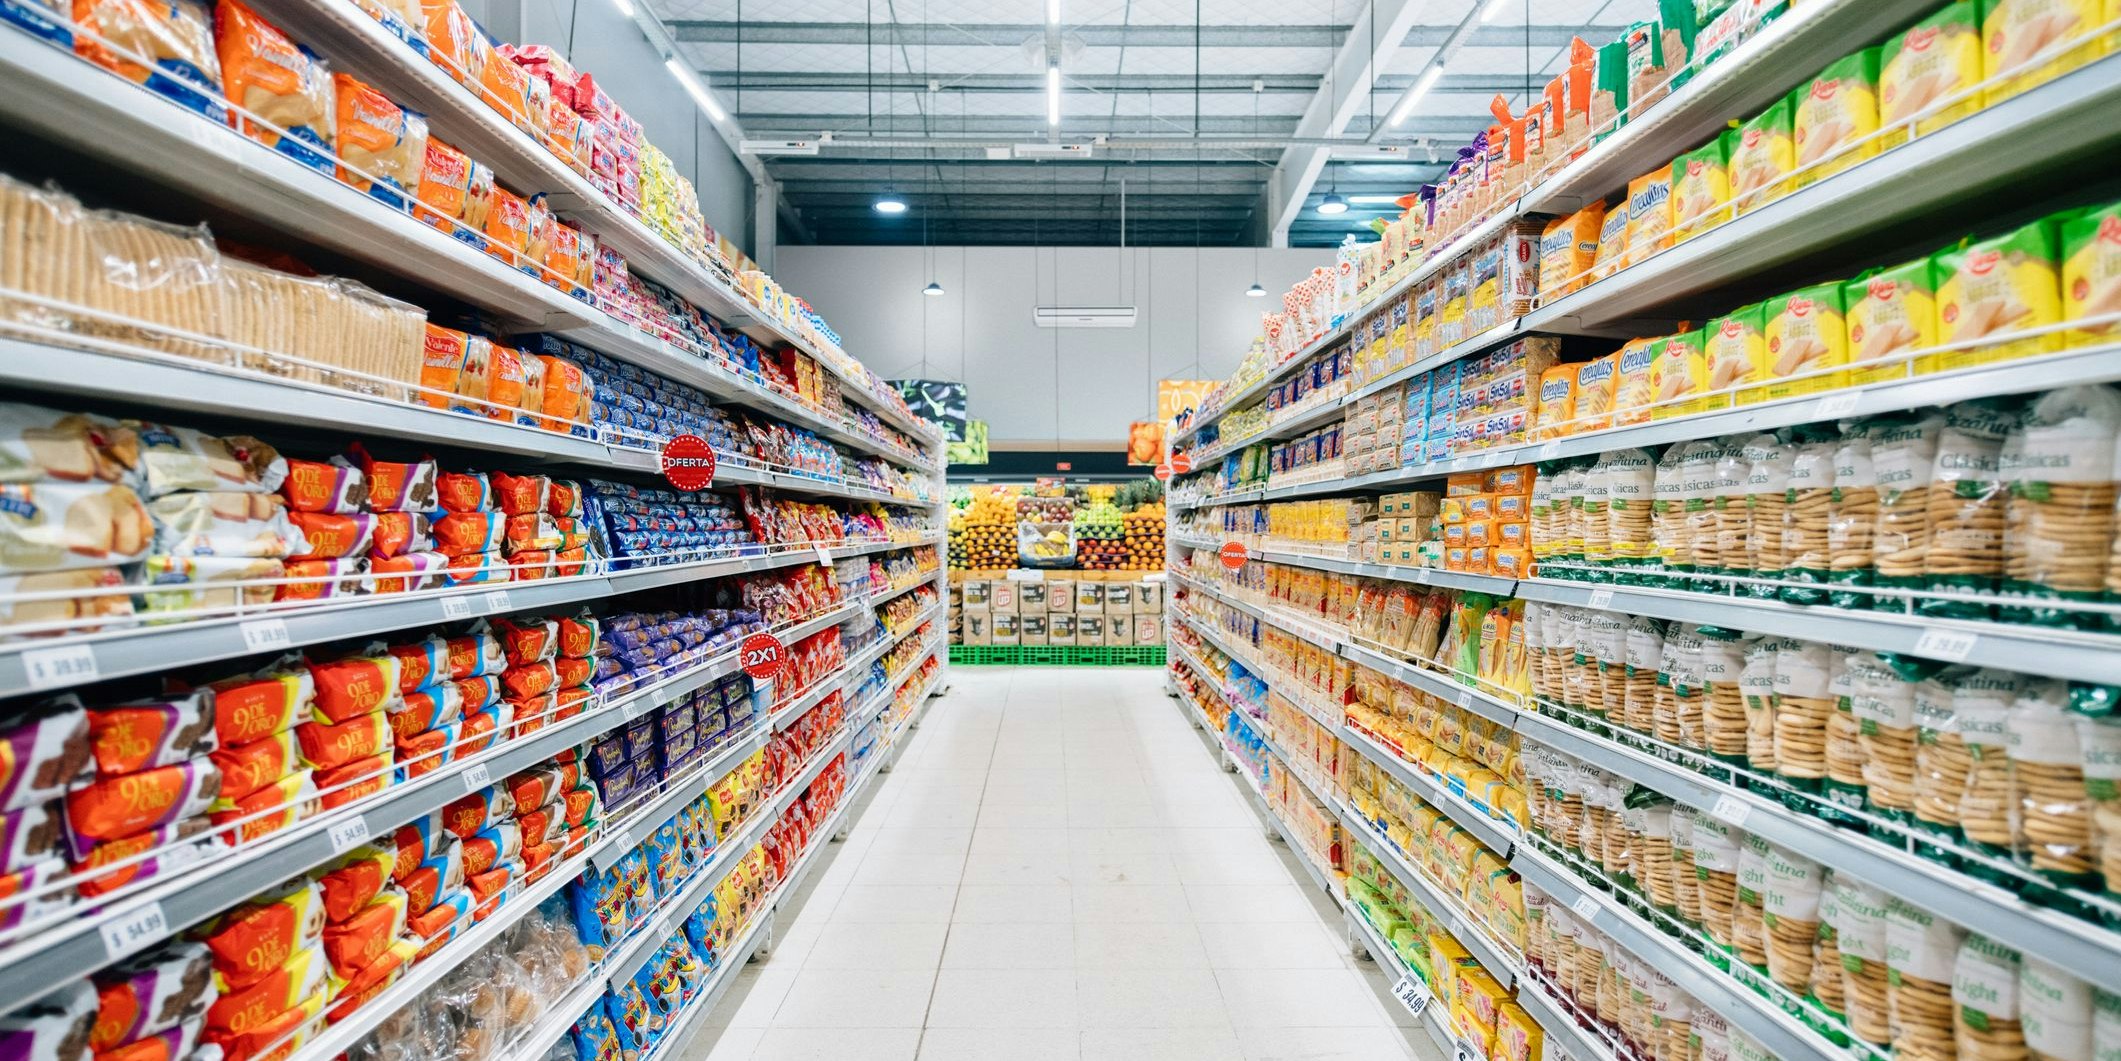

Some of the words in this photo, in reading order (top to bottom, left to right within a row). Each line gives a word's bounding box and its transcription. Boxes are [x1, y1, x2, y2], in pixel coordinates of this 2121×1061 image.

[1630, 182, 1670, 221] Cerealitas
[426, 336, 460, 354] Valente
[669, 457, 710, 468] OFERTA
[1750, 474, 1769, 484] cas
[1600, 620, 1620, 630] tina
[747, 647, 778, 667] 2X1
[1706, 663, 1725, 673] cas
[346, 682, 358, 707] 9
[358, 680, 371, 694] DE
[234, 707, 248, 736] 9
[250, 703, 267, 718] DE
[337, 734, 352, 757] 9
[1580, 764, 1600, 776] tina
[334, 833, 342, 846] $
[344, 823, 366, 842] 54.99
[1744, 867, 1765, 884] ght
[1774, 862, 1806, 880] tina
[1768, 890, 1784, 906] ht
[112, 932, 122, 948] $
[126, 913, 162, 941] 54.99
[246, 947, 266, 972] 9
[1396, 982, 1408, 994] $
[1402, 988, 1426, 1014] 34.99
[1952, 974, 1998, 1003] Light
